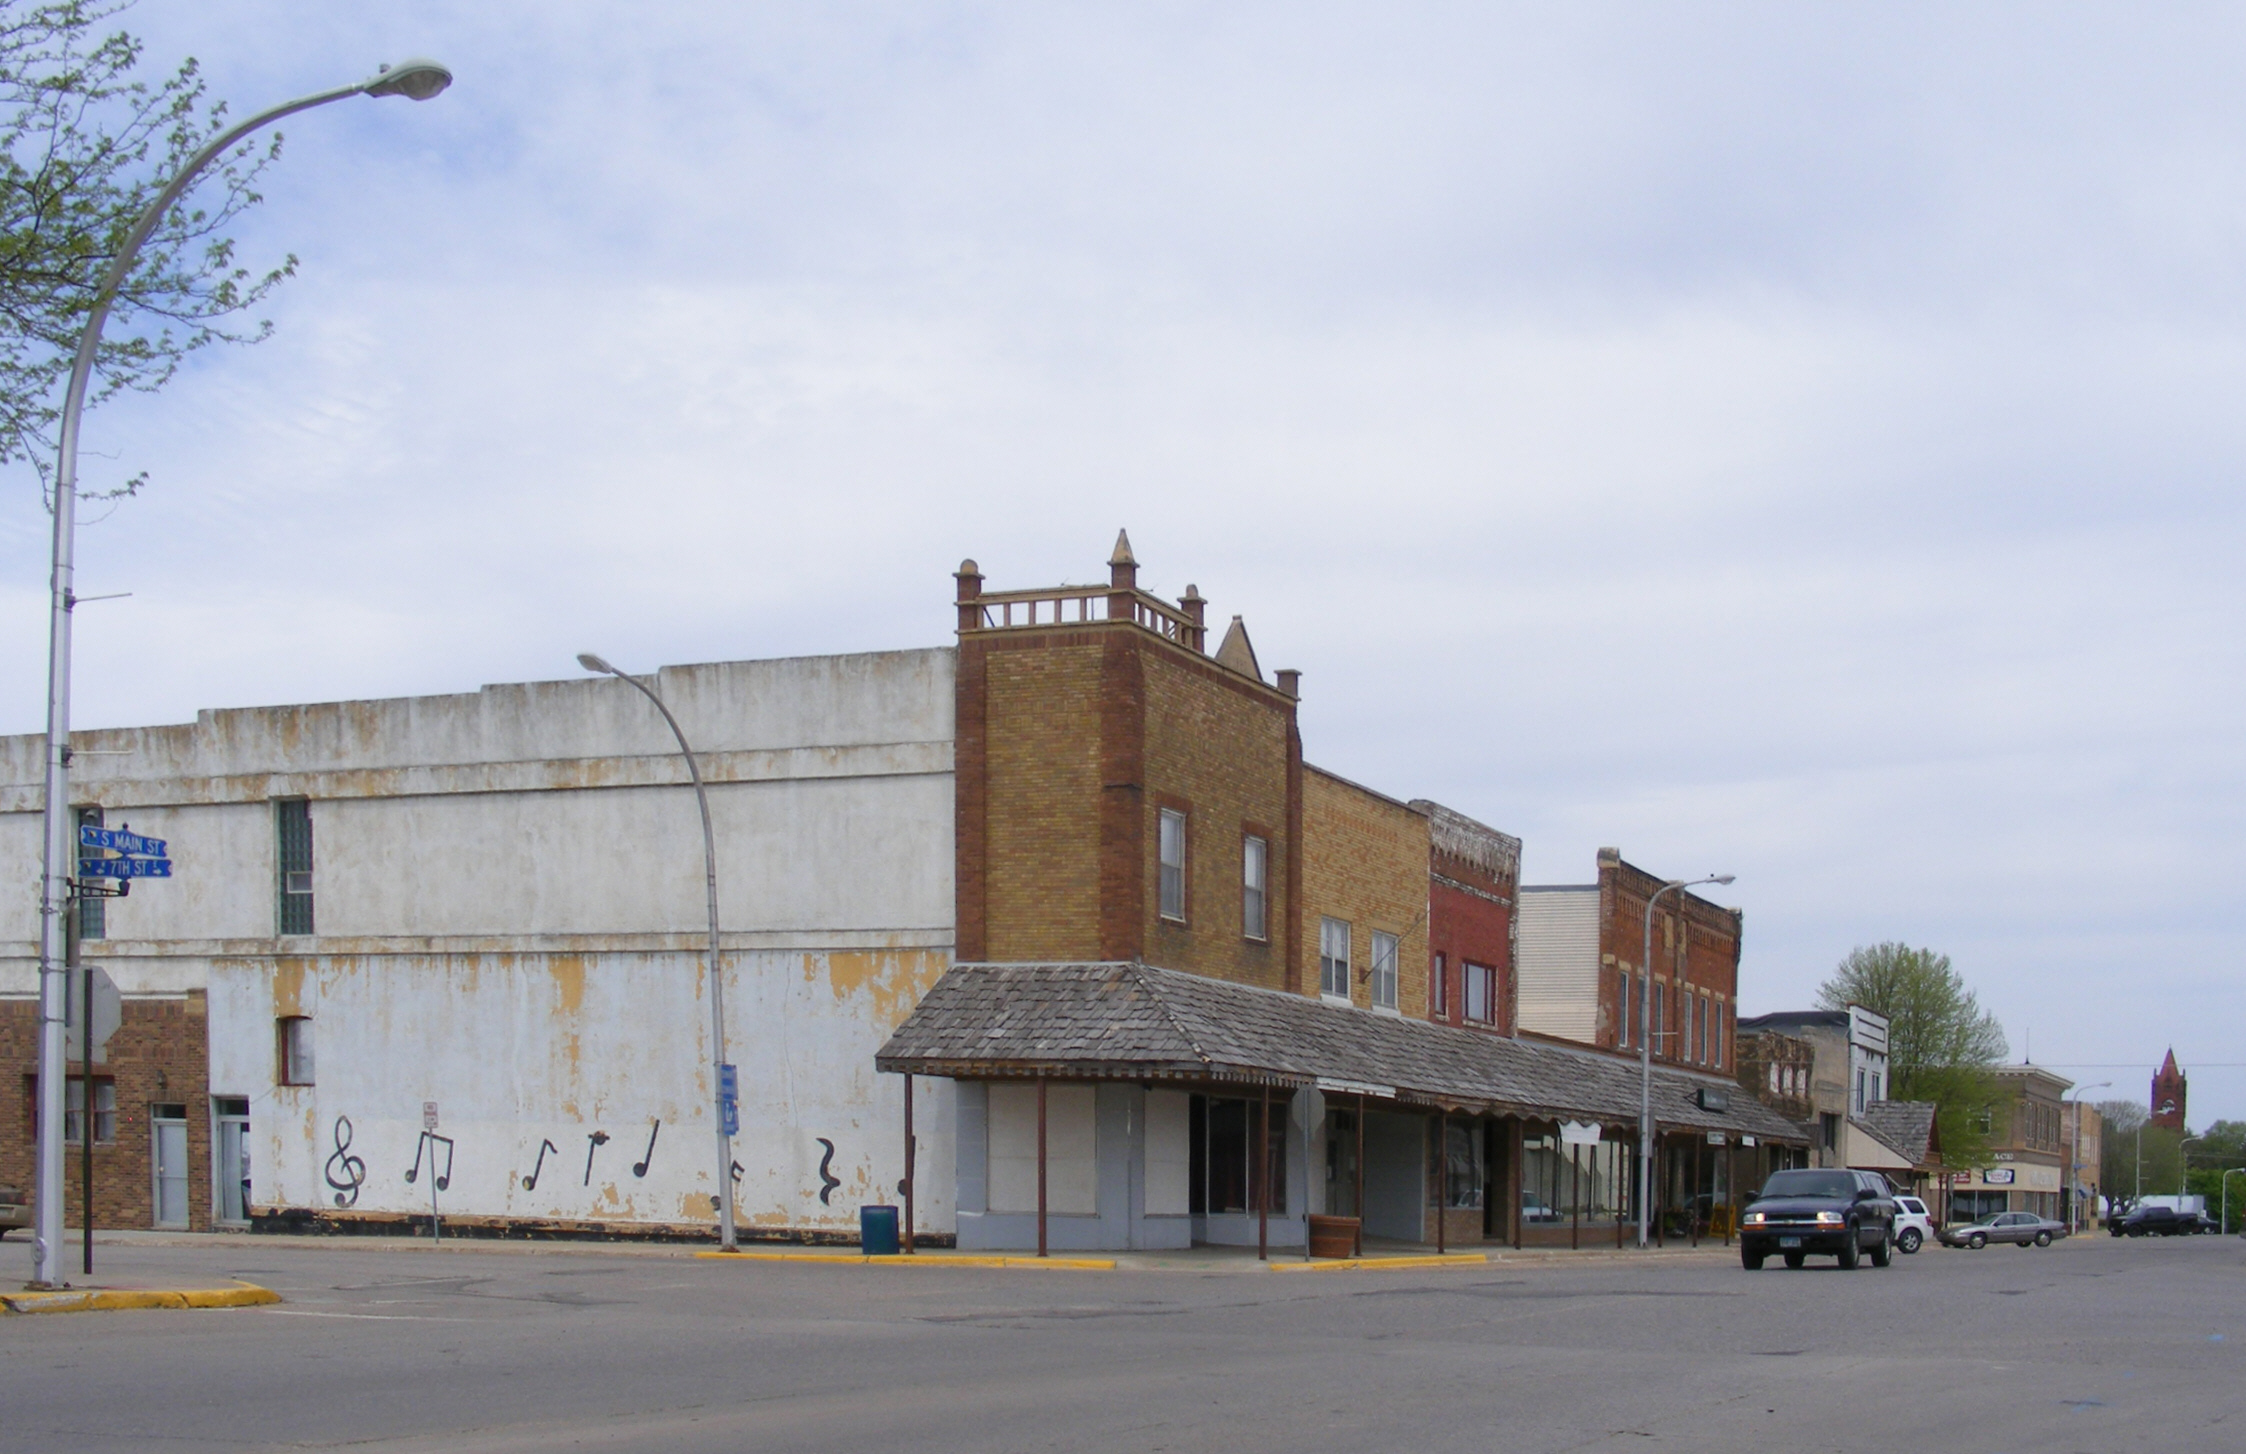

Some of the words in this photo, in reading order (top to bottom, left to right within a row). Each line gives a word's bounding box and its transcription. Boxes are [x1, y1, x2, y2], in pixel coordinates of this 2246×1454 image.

[101, 831, 110, 846] S
[115, 834, 142, 852] MAIN
[147, 839, 161, 855] ST
[110, 861, 131, 875] 7TH
[134, 860, 148, 875] ST
